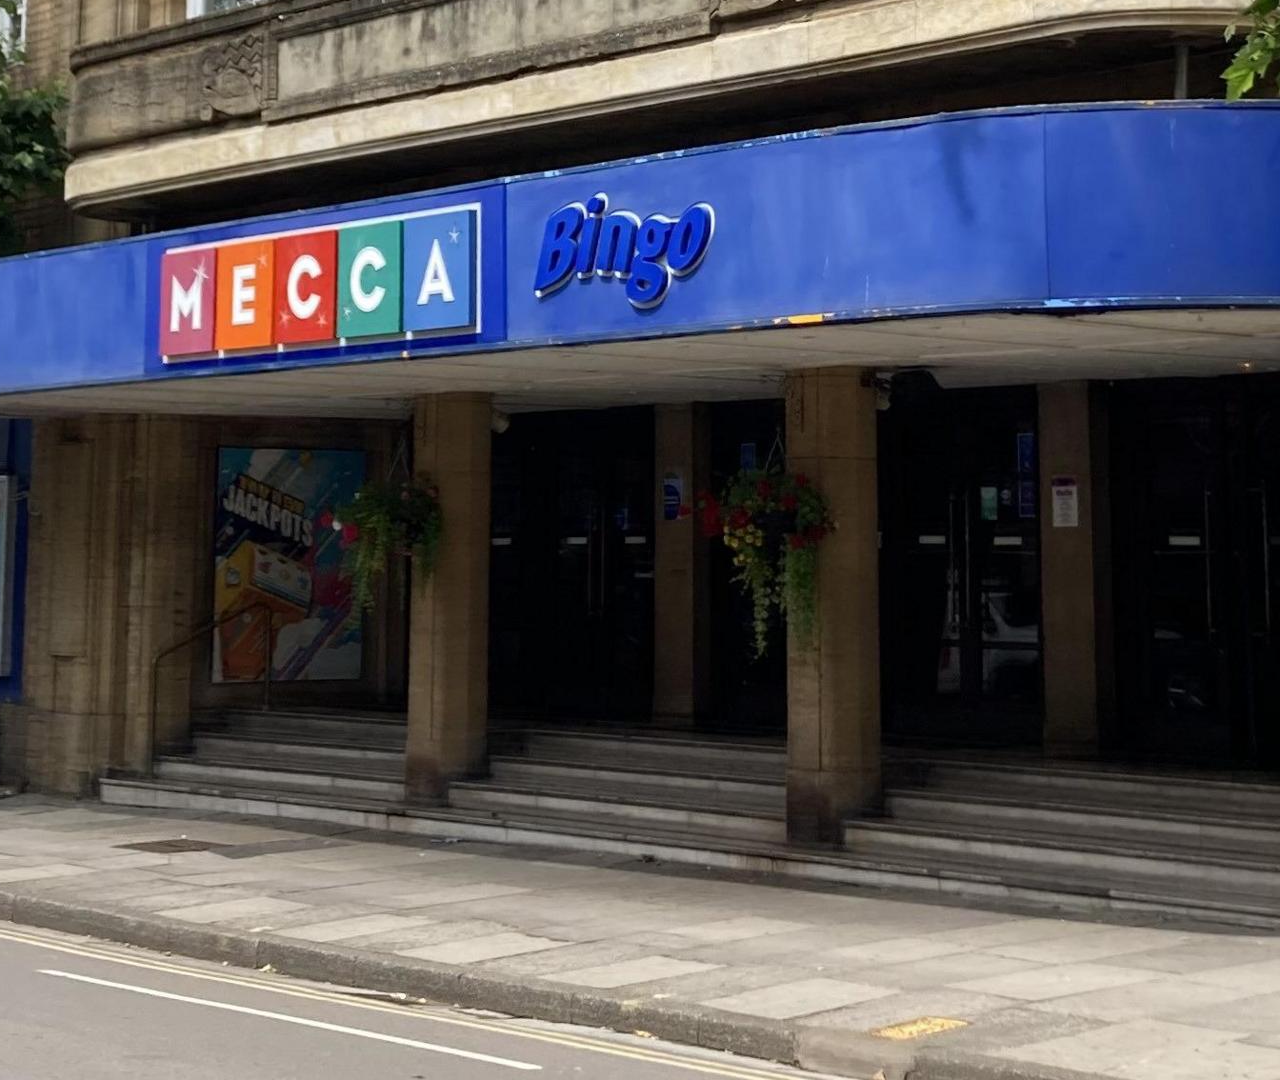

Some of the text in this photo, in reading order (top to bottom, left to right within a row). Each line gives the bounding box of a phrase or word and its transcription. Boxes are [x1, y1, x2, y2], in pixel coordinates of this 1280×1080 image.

[169, 238, 455, 333] MECCA
[533, 191, 716, 310] Bingo
[223, 485, 313, 547] JACKPOTS
